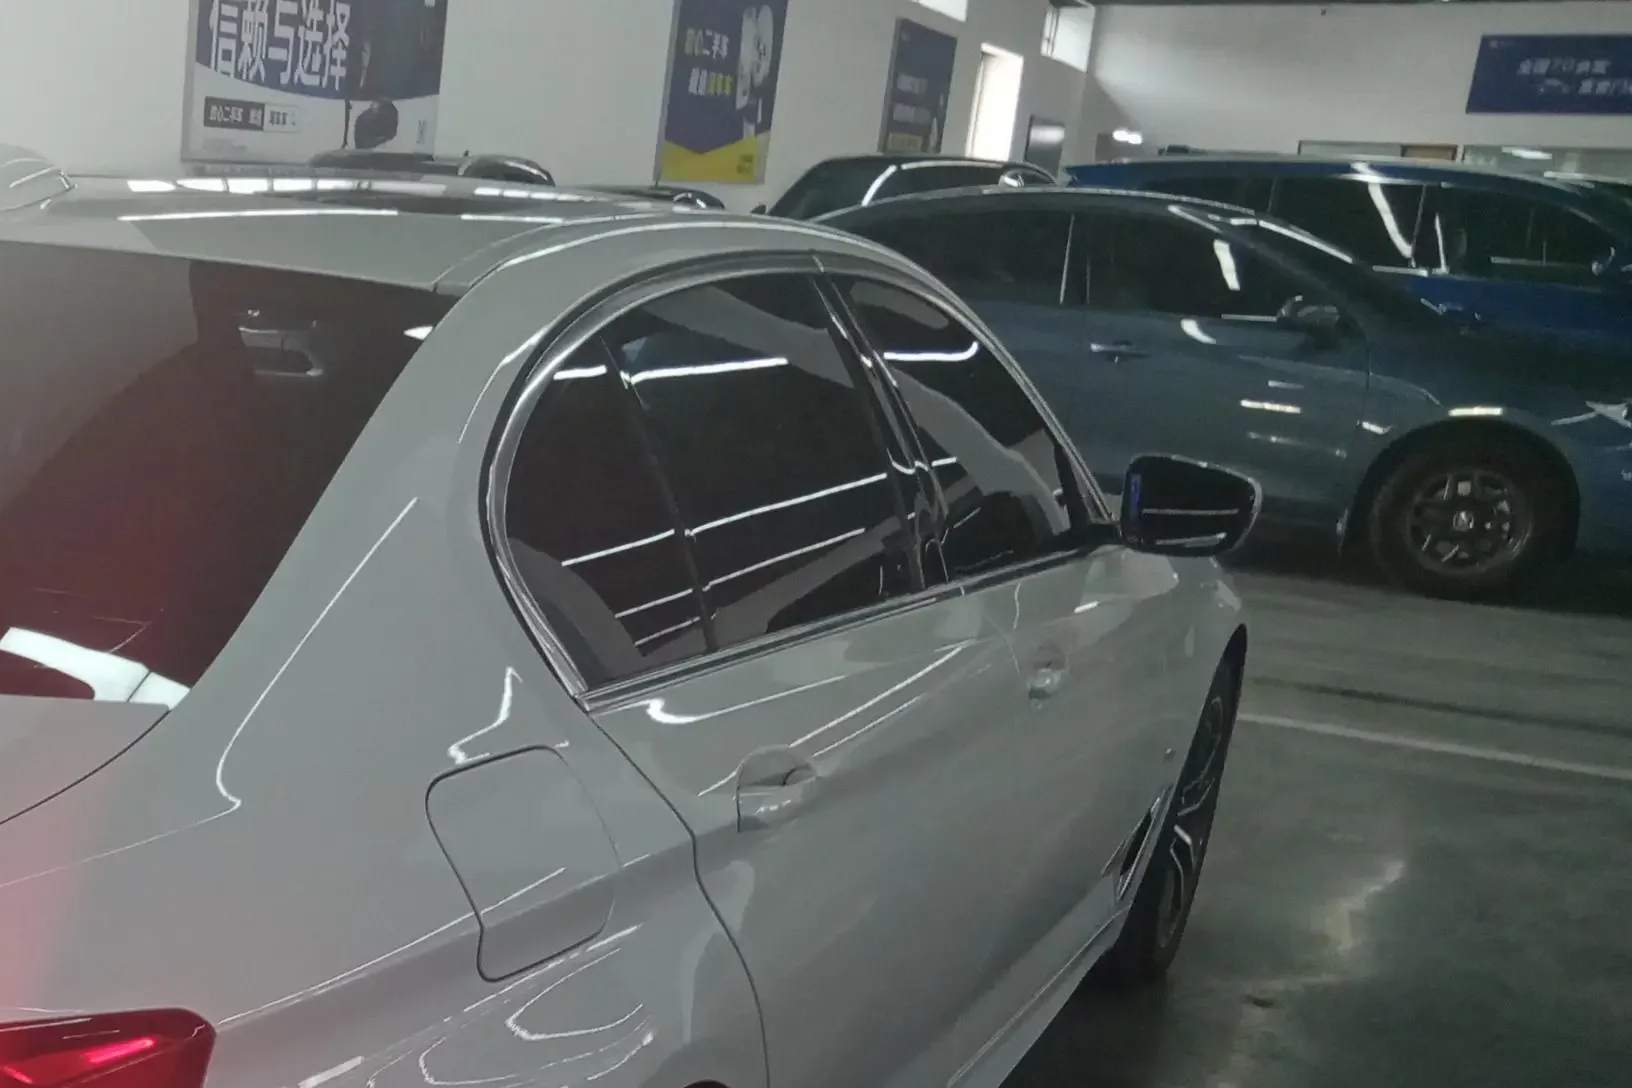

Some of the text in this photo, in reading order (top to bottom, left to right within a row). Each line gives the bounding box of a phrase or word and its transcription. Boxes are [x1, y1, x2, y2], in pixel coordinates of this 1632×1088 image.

[209, 0, 350, 91] 信赖与选择
